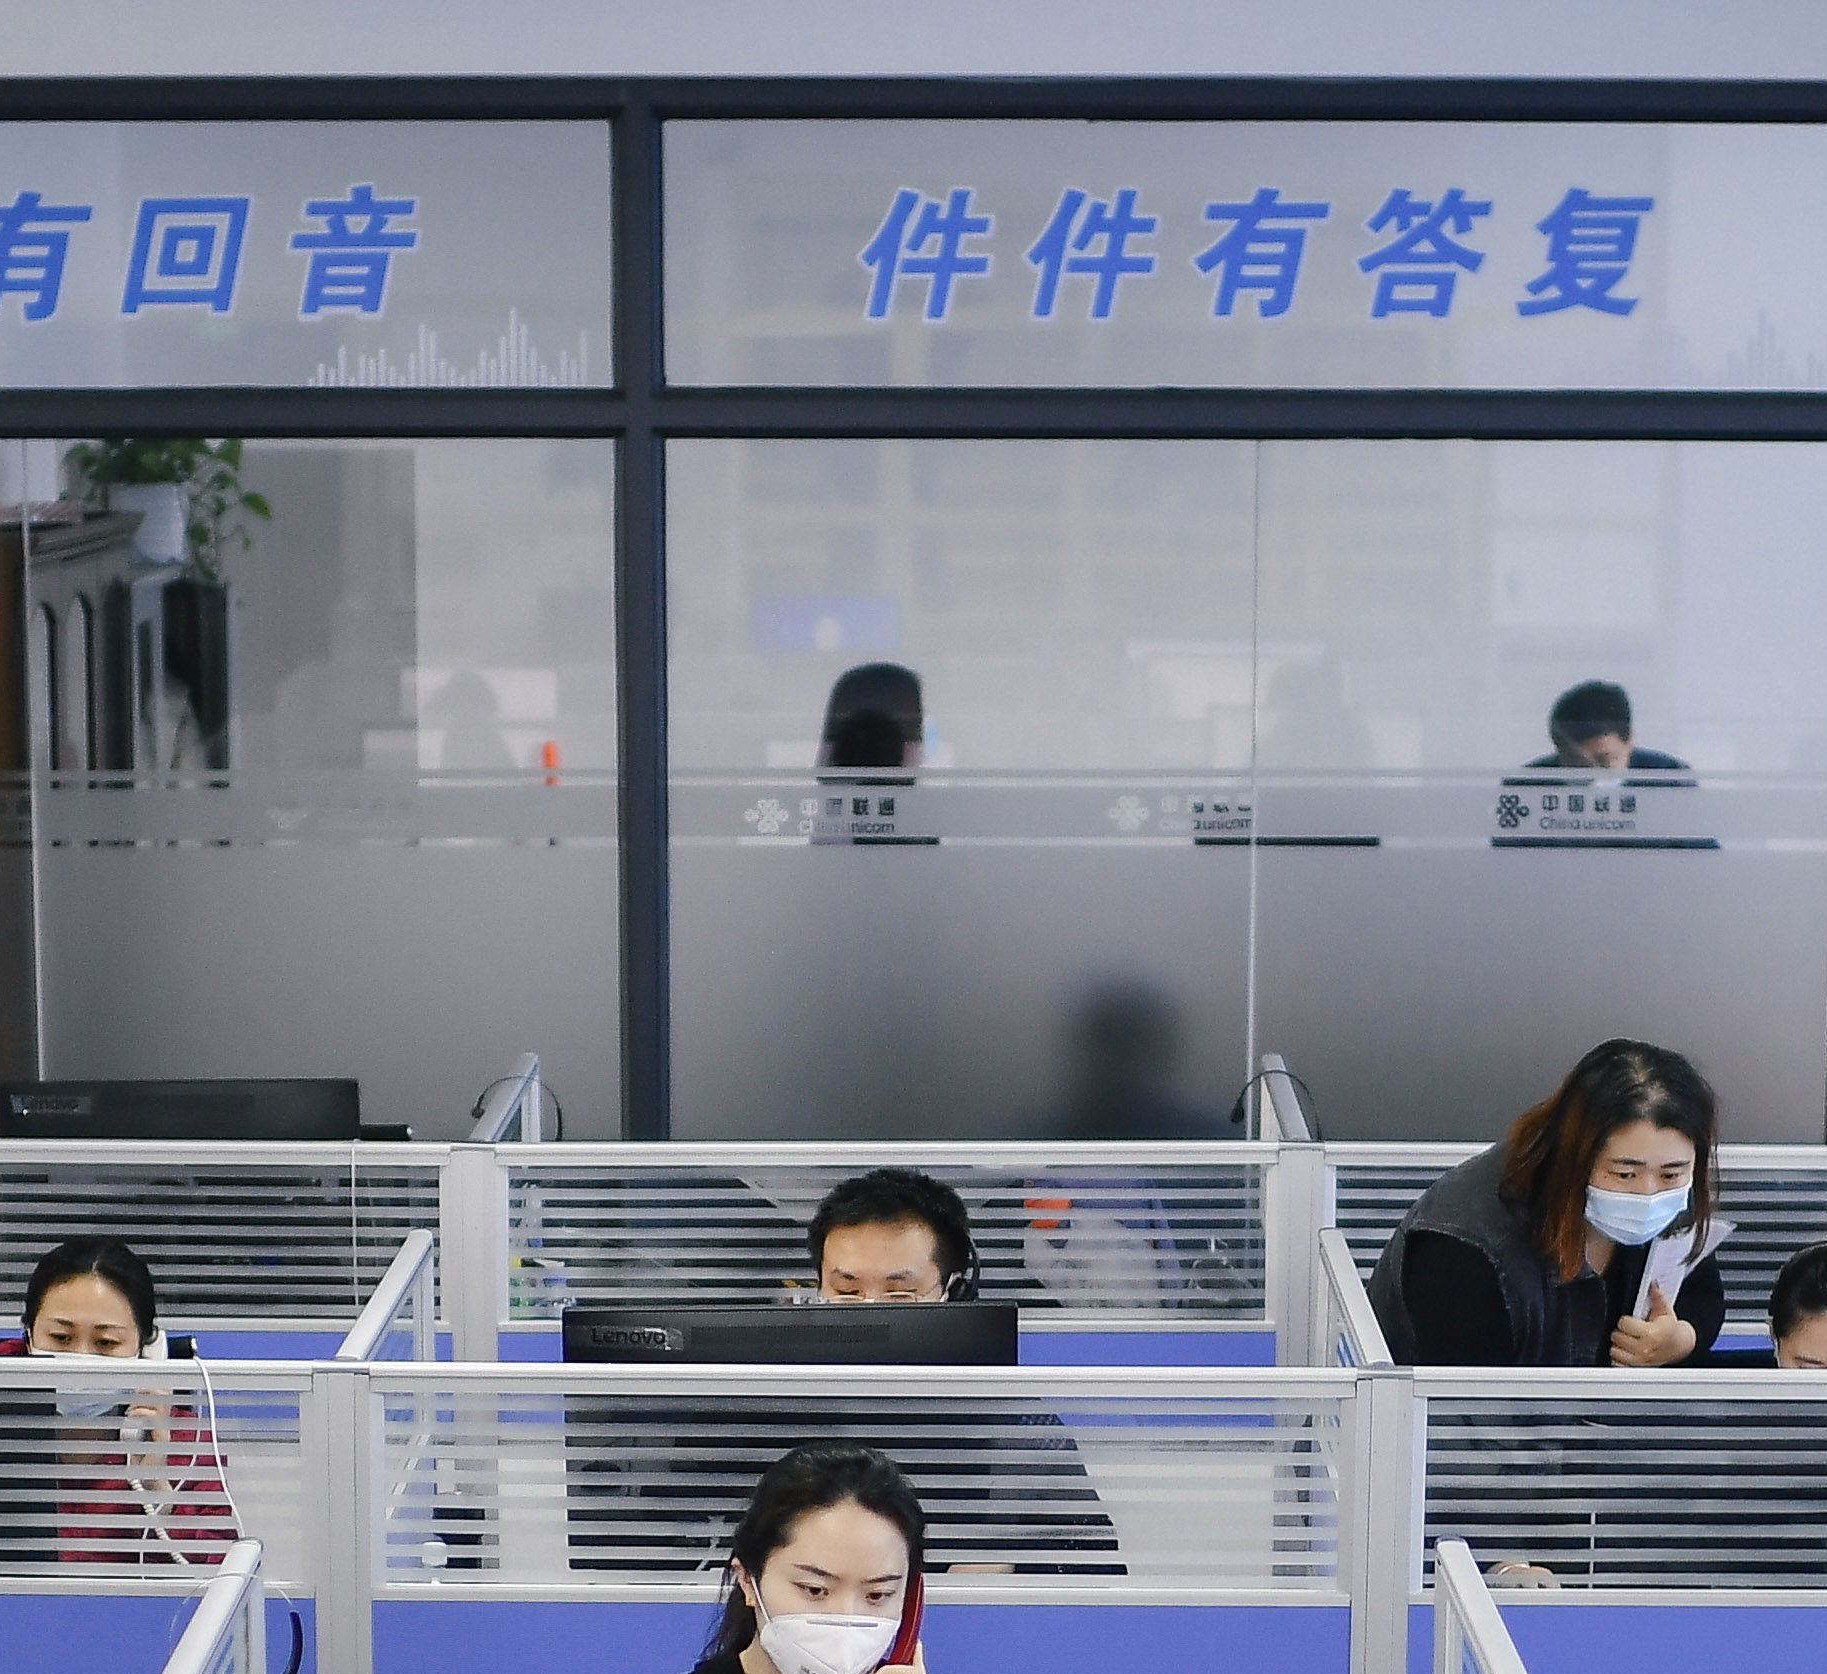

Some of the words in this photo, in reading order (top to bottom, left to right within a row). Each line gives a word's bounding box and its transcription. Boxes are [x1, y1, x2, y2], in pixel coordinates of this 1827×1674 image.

[860, 186, 1656, 321] 件件有答复
